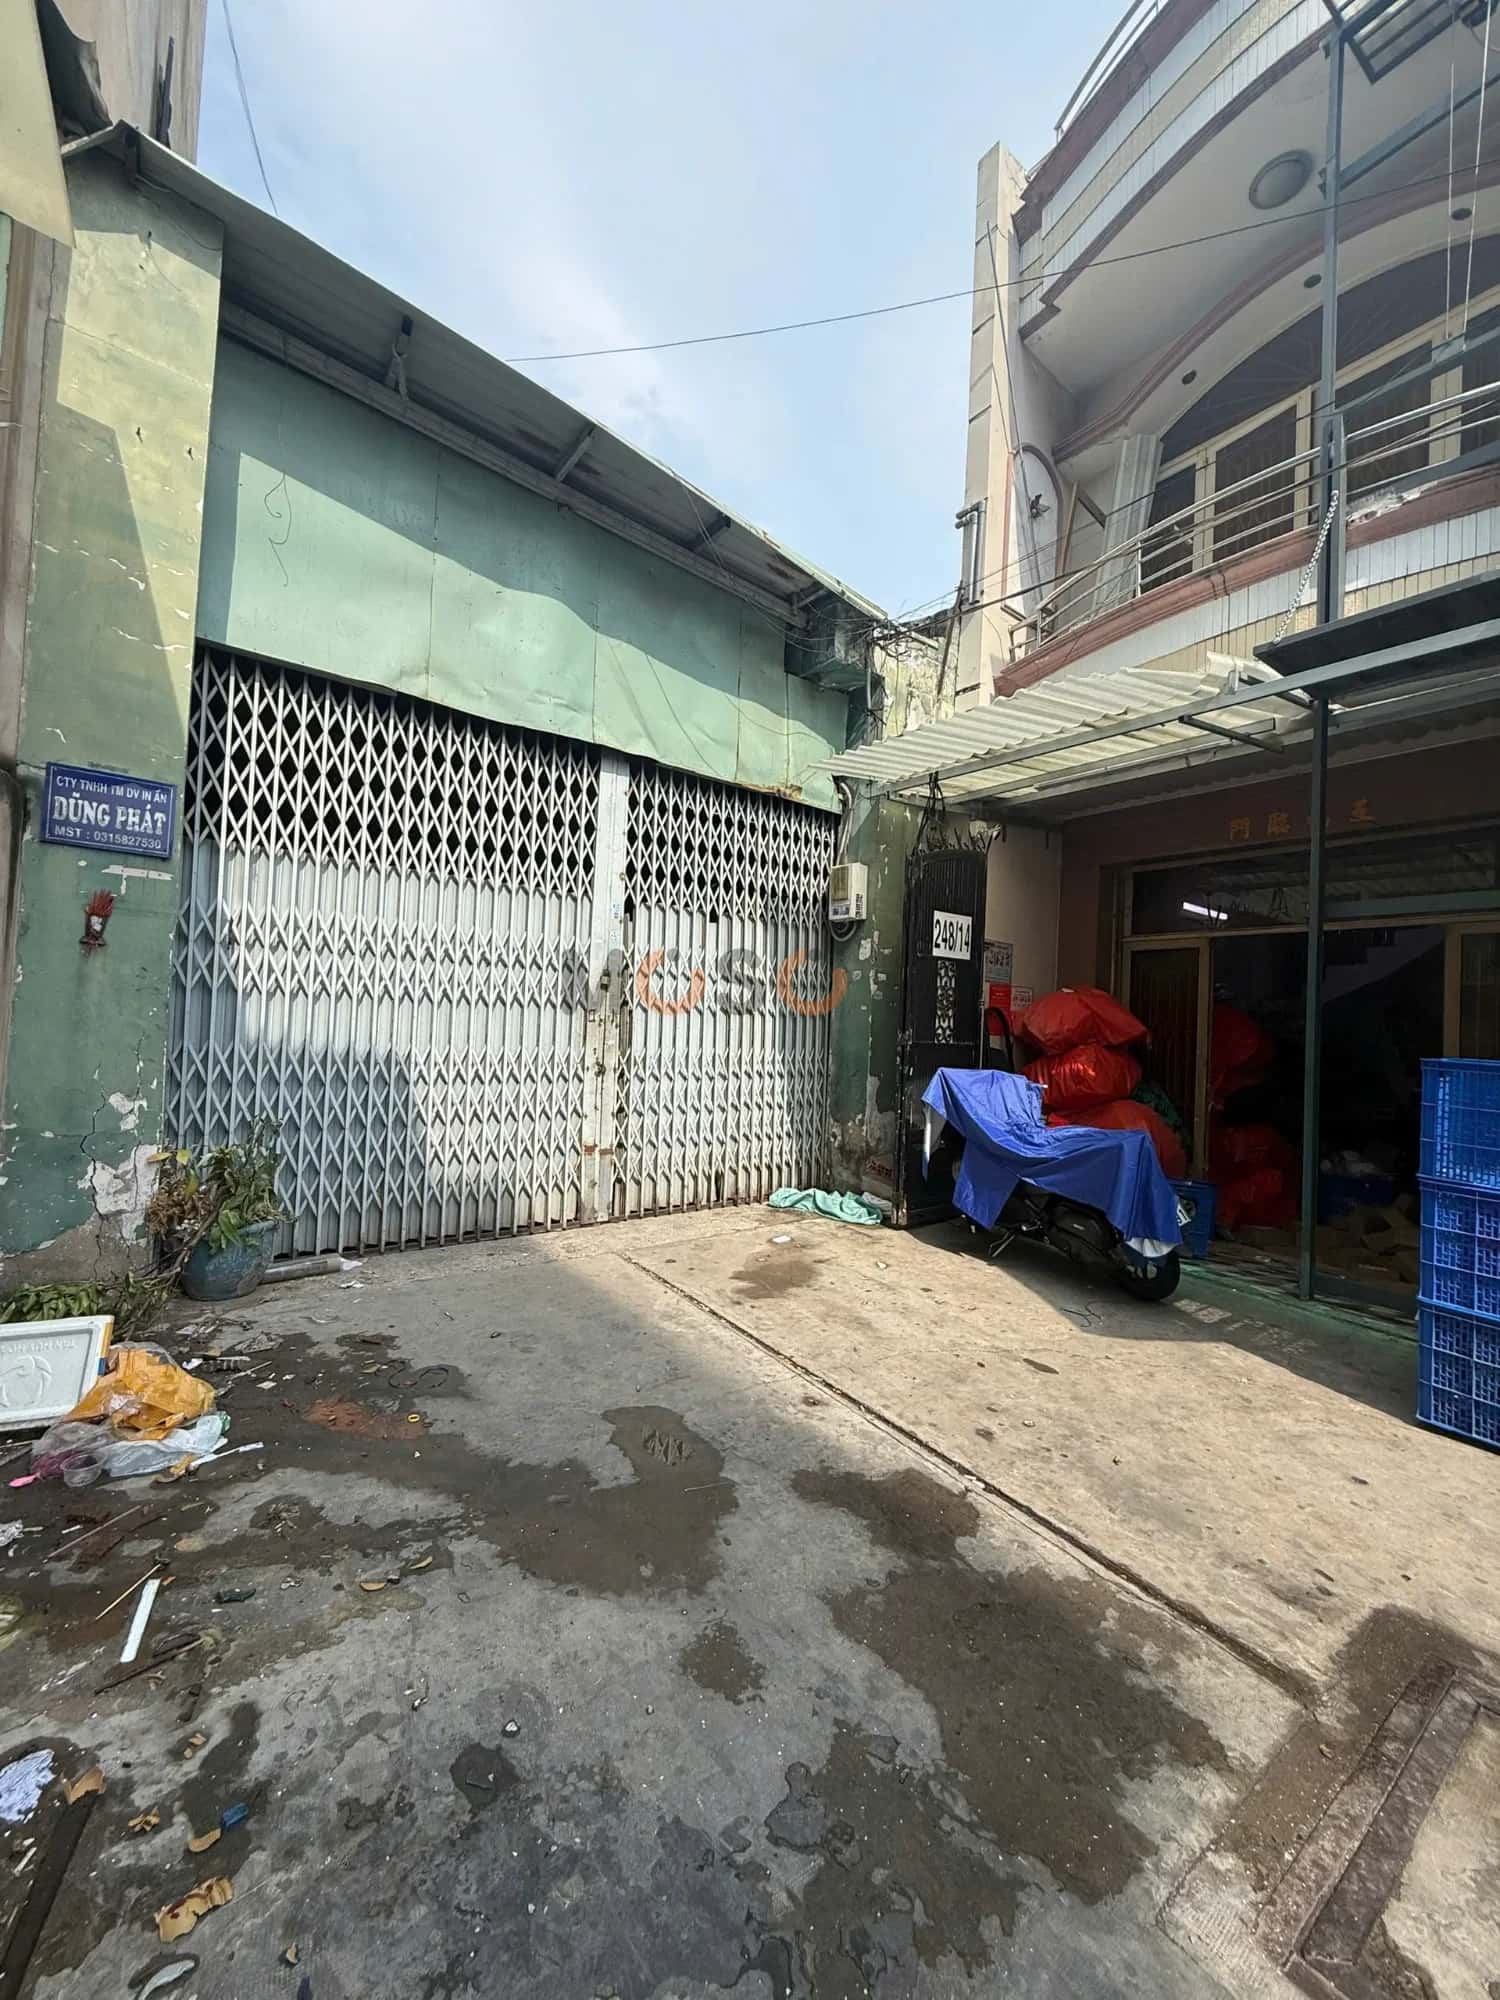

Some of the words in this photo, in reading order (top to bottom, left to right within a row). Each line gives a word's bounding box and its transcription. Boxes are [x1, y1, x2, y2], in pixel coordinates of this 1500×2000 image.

[56, 775, 77, 788] CTY
[80, 780, 107, 794] TNHH
[111, 785, 124, 796] TM
[126, 788, 139, 799] DV
[142, 790, 152, 802] IN
[52, 791, 110, 827] DŨNG
[115, 804, 166, 835] PHÁT
[54, 825, 82, 839] MST
[934, 918, 970, 953] 248/14
